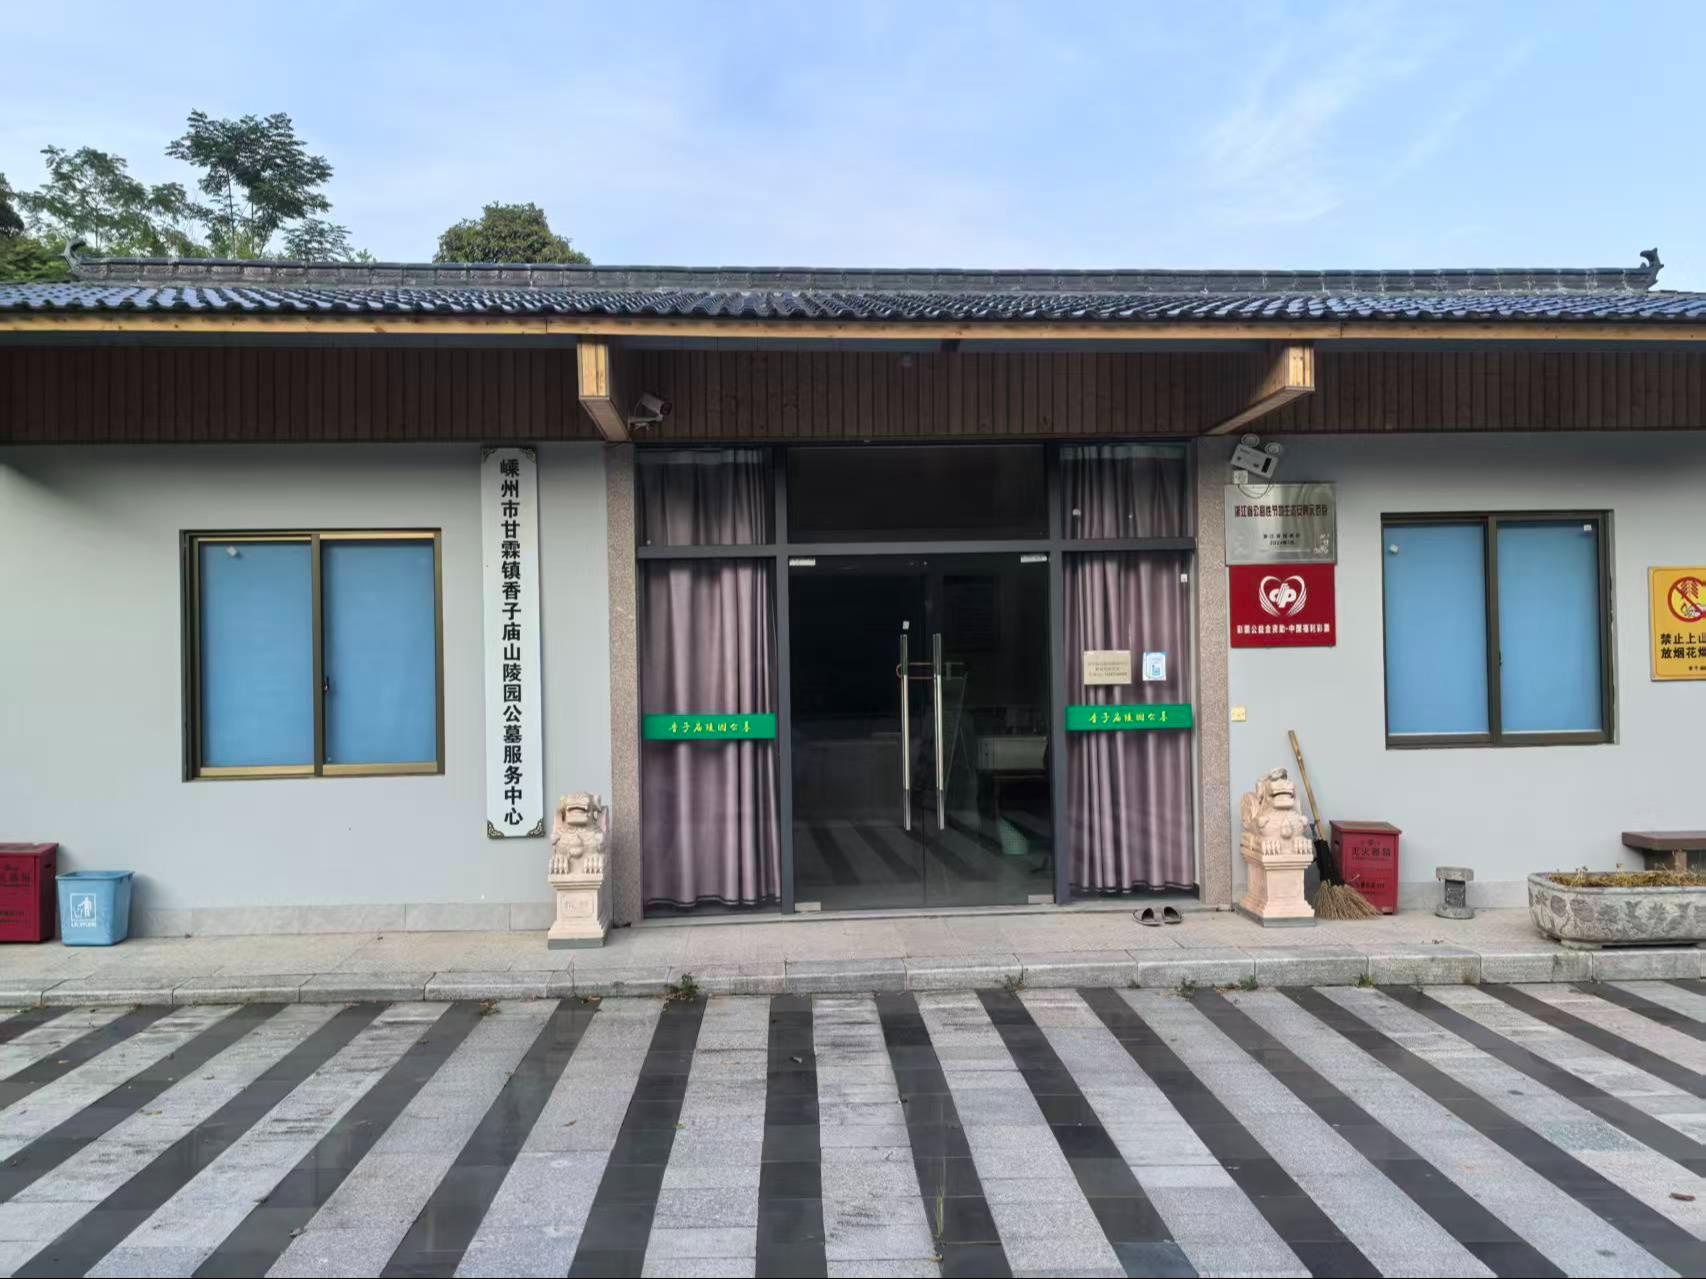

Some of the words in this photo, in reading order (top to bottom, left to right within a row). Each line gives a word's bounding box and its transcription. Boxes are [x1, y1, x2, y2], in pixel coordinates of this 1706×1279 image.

[499, 458, 523, 827] 嵊州市甘霖镇香子庙山陵园公墓服务中心
